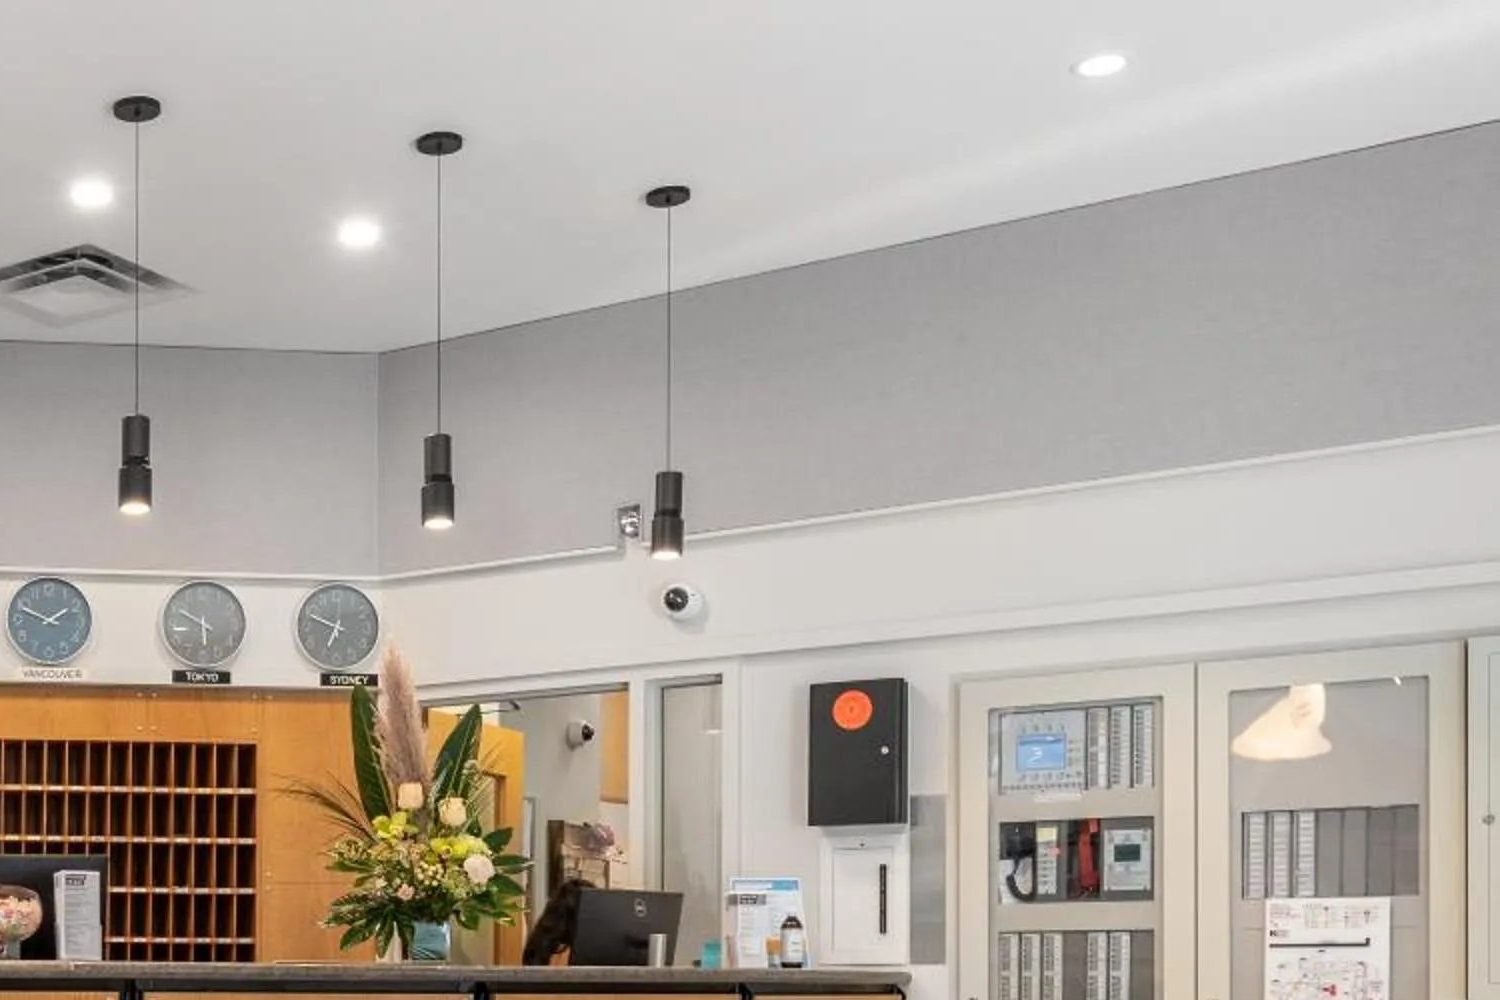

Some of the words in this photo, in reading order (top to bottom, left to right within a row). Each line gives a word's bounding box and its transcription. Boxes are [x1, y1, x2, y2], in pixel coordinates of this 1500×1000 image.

[22, 668, 83, 679] VANCOUVER
[185, 671, 219, 682] TOKYO
[329, 675, 370, 685] SYDNEY
